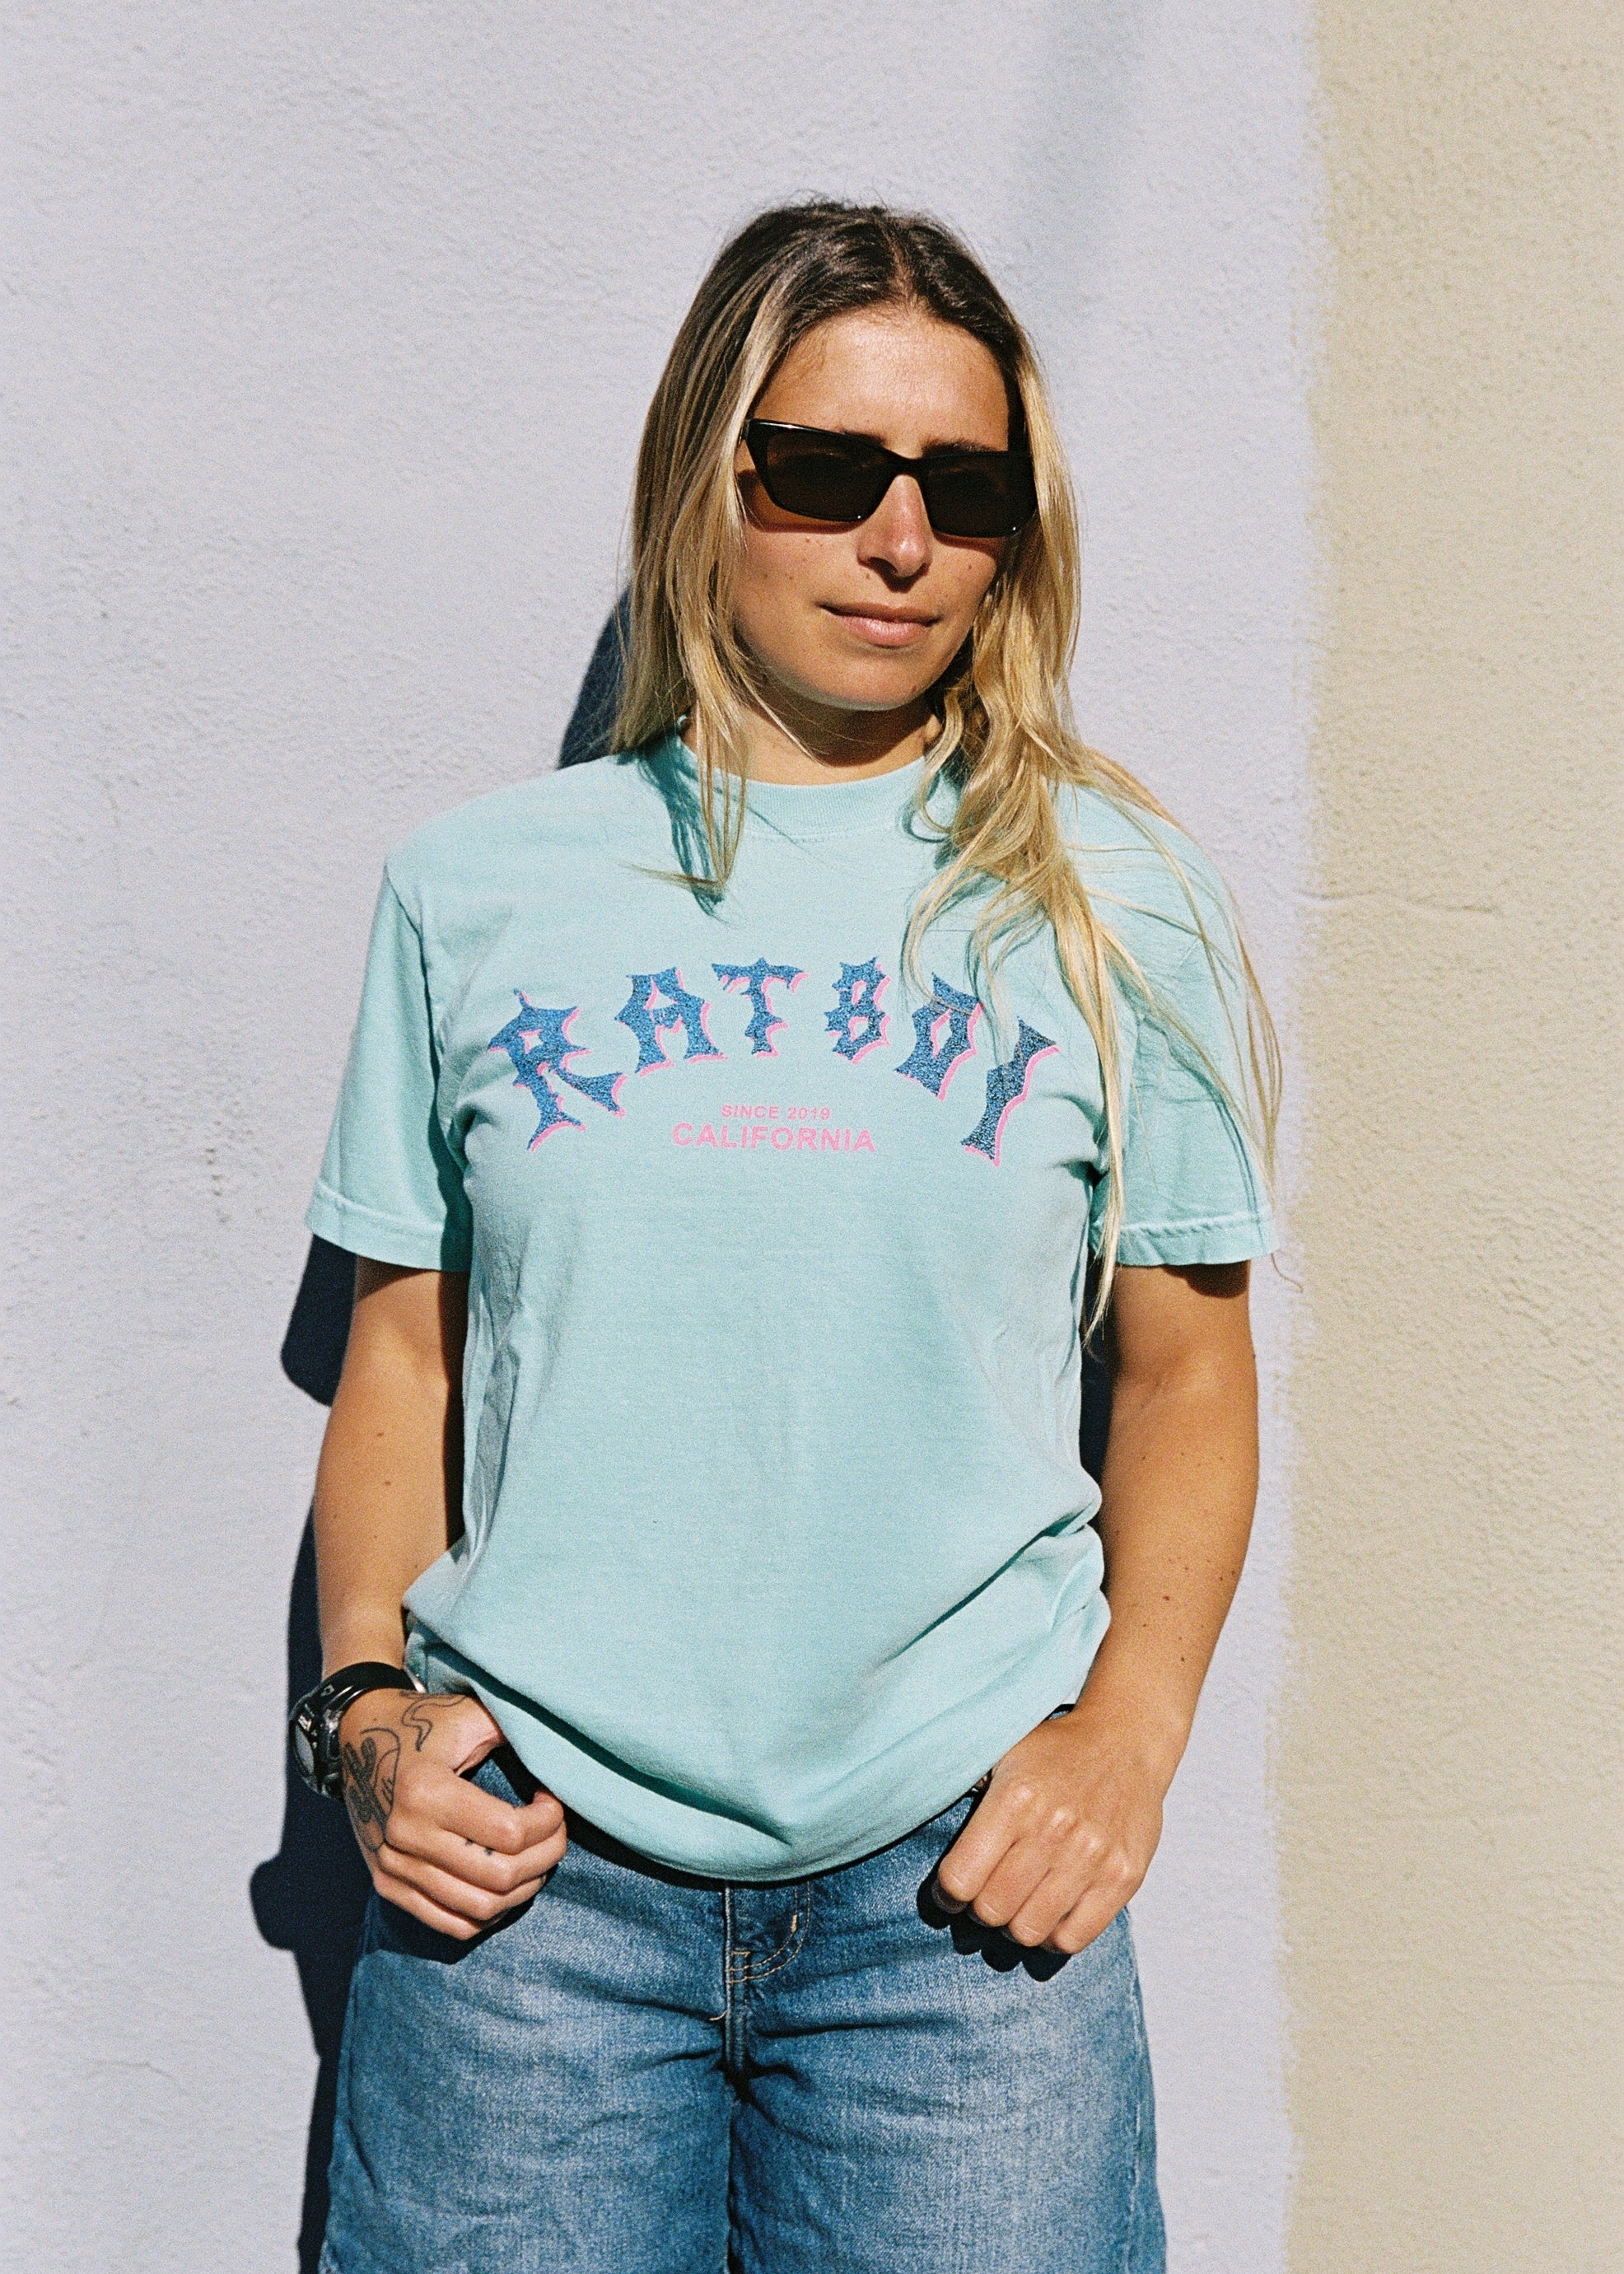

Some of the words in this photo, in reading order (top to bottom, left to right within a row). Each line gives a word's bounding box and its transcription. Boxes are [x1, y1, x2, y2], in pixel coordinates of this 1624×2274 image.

[721, 1104, 780, 1119] SINCE
[786, 1105, 831, 1121] 2019
[672, 1122, 876, 1152] CALIFORNIA
